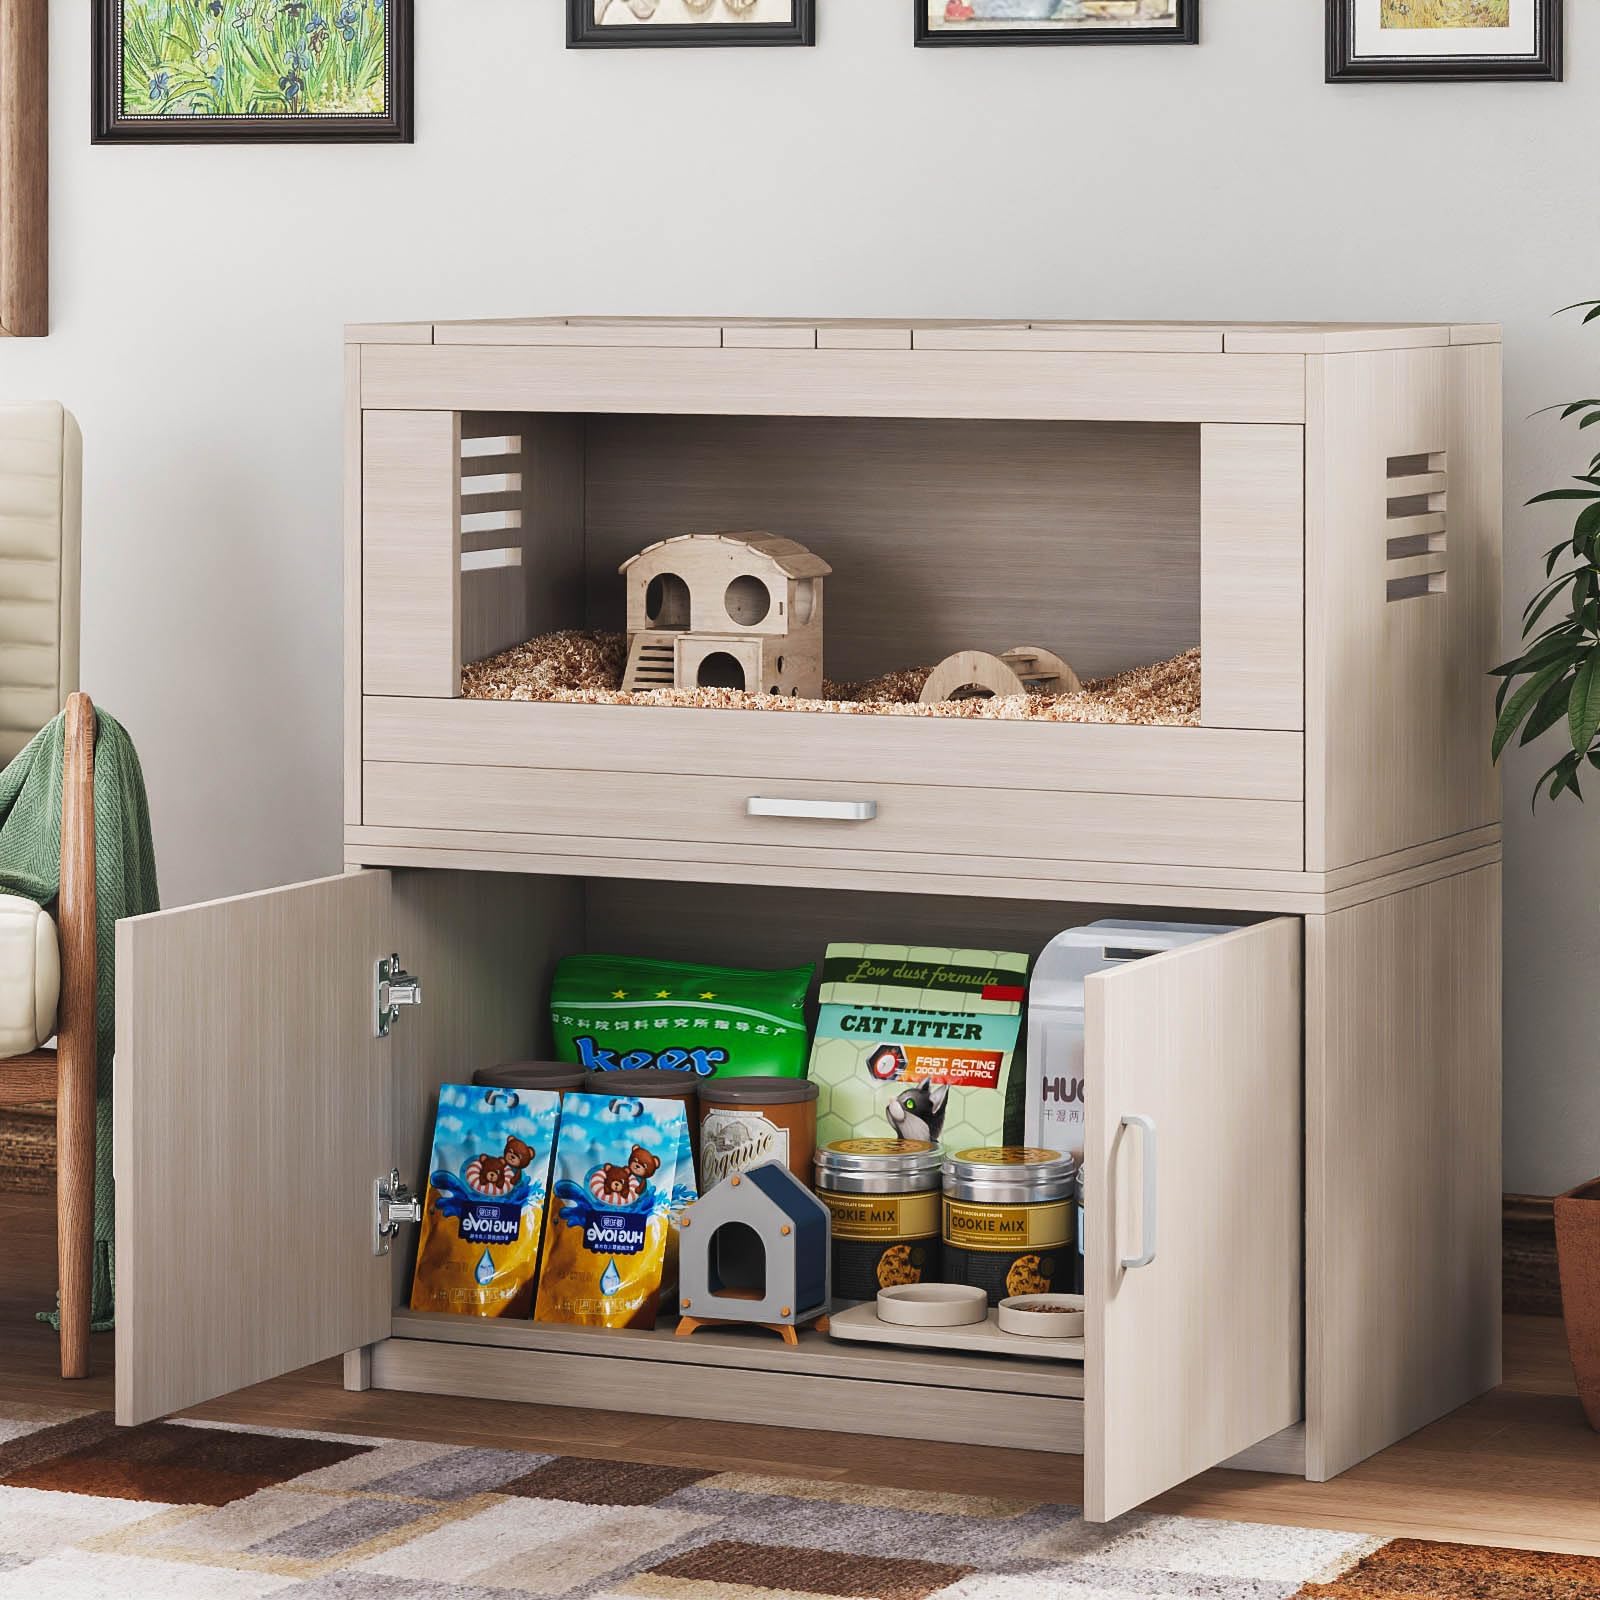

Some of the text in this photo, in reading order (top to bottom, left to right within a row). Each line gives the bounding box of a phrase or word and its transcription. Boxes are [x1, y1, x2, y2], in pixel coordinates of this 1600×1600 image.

[846, 961, 999, 987] Low dust formula
[840, 1015, 983, 1040] CAT LITTER
[574, 1036, 727, 1077] keer
[915, 1056, 996, 1071] FAST ACTING
[914, 1067, 993, 1079] ODOUR CONTROL
[701, 1132, 773, 1184] Organic
[831, 1208, 895, 1221] OOKIE MIX
[952, 1216, 1025, 1232] COOKIE MIX
